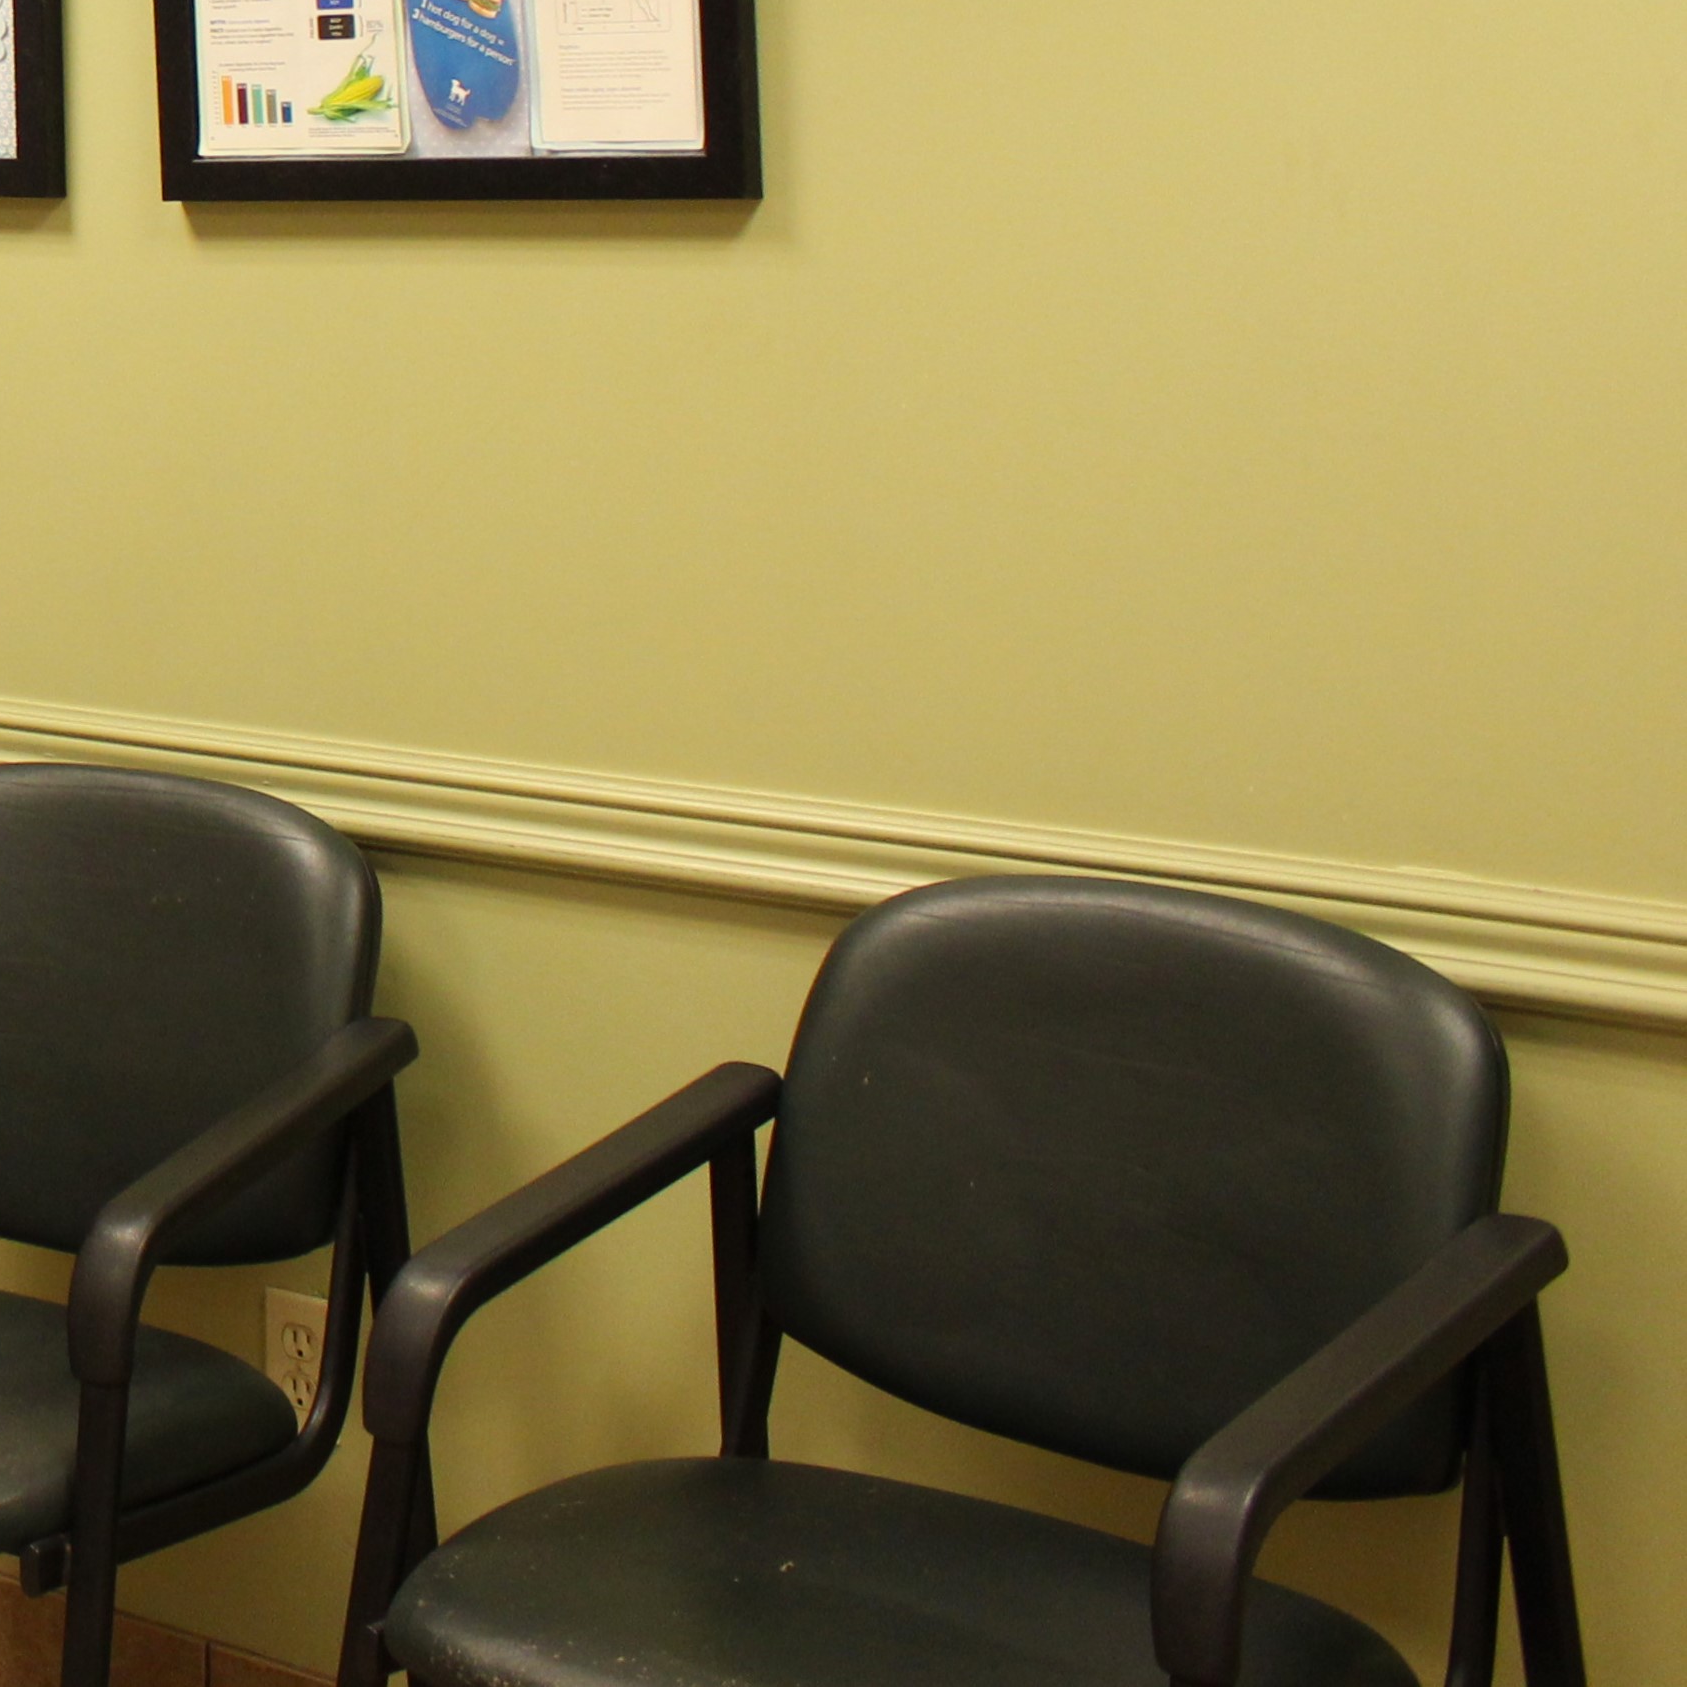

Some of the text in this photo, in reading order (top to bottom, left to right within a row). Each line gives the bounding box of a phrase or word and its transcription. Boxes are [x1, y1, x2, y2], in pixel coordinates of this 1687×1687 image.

[419, 12, 466, 43] hamburgers
[466, 36, 479, 48] for
[479, 44, 486, 52] a
[427, 1, 443, 16] hot
[443, 11, 461, 26] dog
[461, 17, 473, 30] for
[473, 25, 480, 34] a
[480, 29, 497, 44] dog
